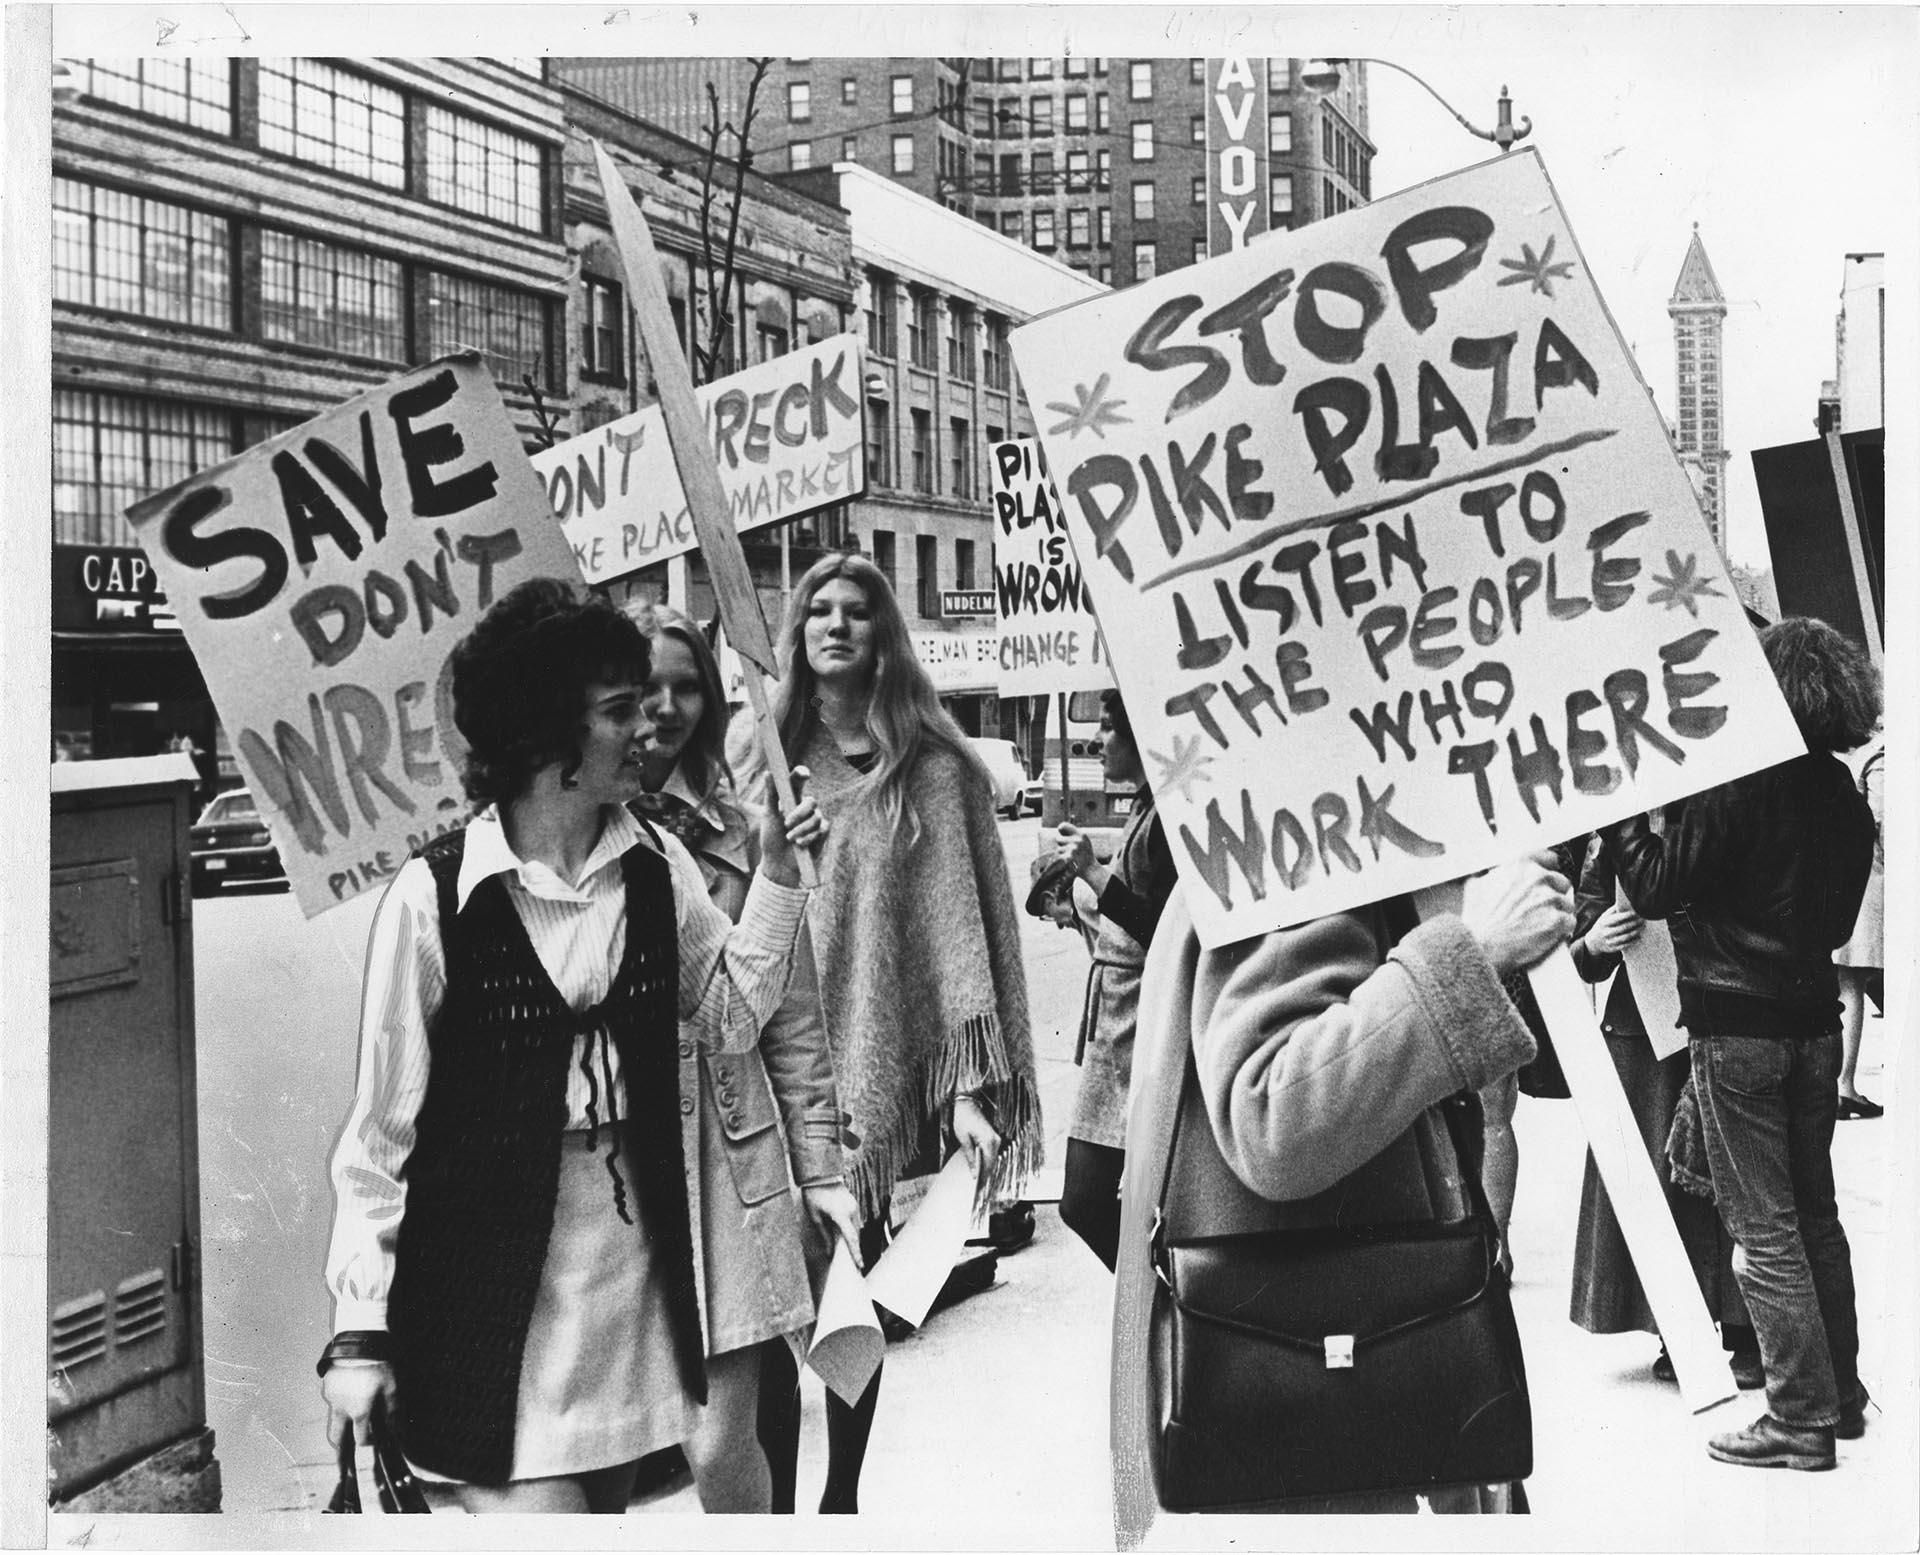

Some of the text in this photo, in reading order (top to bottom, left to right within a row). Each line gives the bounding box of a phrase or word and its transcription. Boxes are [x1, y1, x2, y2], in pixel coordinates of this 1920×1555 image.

[1124, 205, 1495, 424] STOP
[162, 369, 499, 620] SAVE
[536, 350, 859, 521] ON'T RECK
[731, 442, 861, 522] MARKET
[1066, 317, 1600, 584] PIKE PLAZA
[290, 527, 523, 668] DON'T
[1038, 536, 1067, 566] IS
[1165, 510, 1652, 750] THE PEOPLE
[1172, 470, 1567, 670] LISTEN TO
[999, 630, 1080, 671] CHANGE
[1349, 660, 1515, 763] WHO
[1179, 629, 1729, 912] WORK THERE
[328, 852, 401, 900] PIKE
